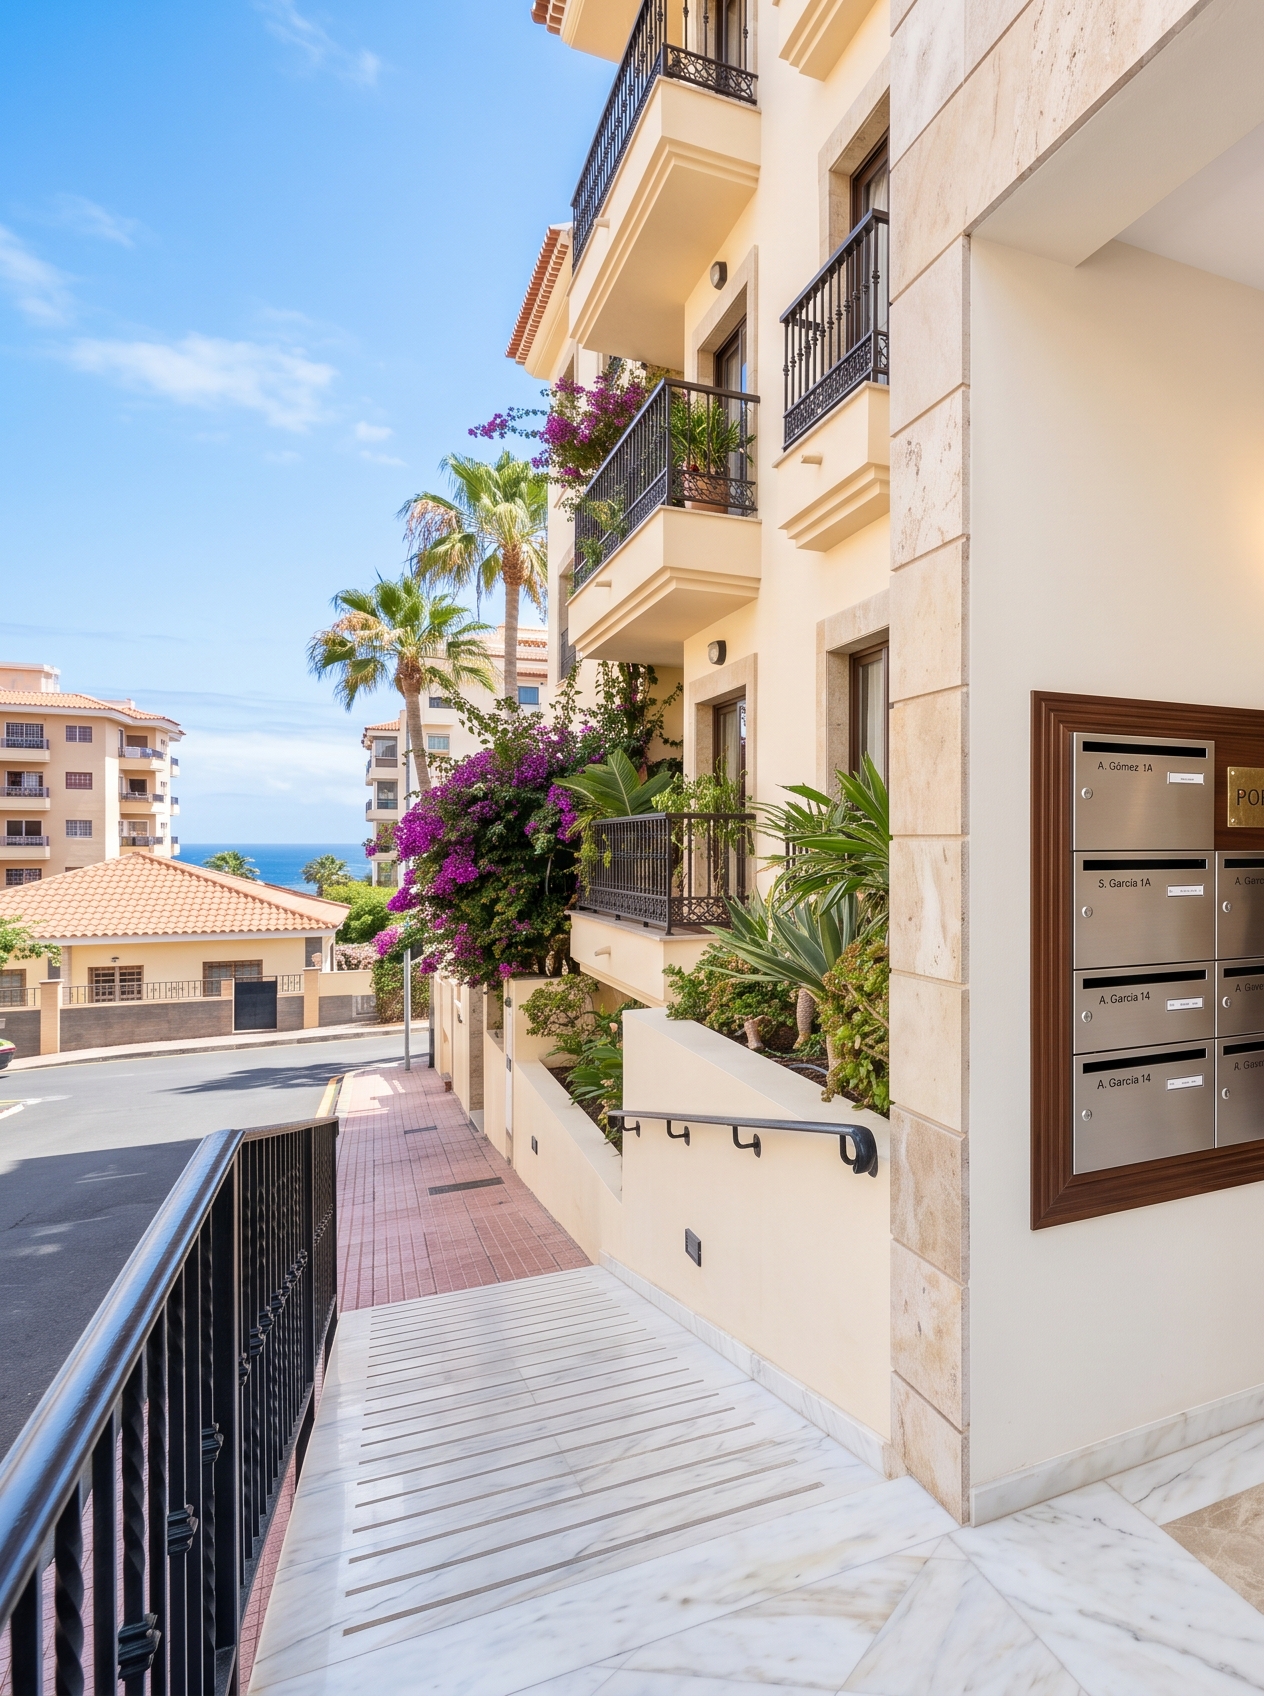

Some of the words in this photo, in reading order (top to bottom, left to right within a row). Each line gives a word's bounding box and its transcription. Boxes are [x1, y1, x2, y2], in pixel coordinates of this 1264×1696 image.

[1097, 761, 1107, 770] A.
[1109, 761, 1139, 772] Gómez
[1098, 878, 1107, 888] S.
[1140, 878, 1151, 887] 1A
[1099, 995, 1109, 1005] A.
[1140, 991, 1150, 1001] 14
[1097, 1079, 1107, 1090] A.
[1141, 1073, 1151, 1083] 14
